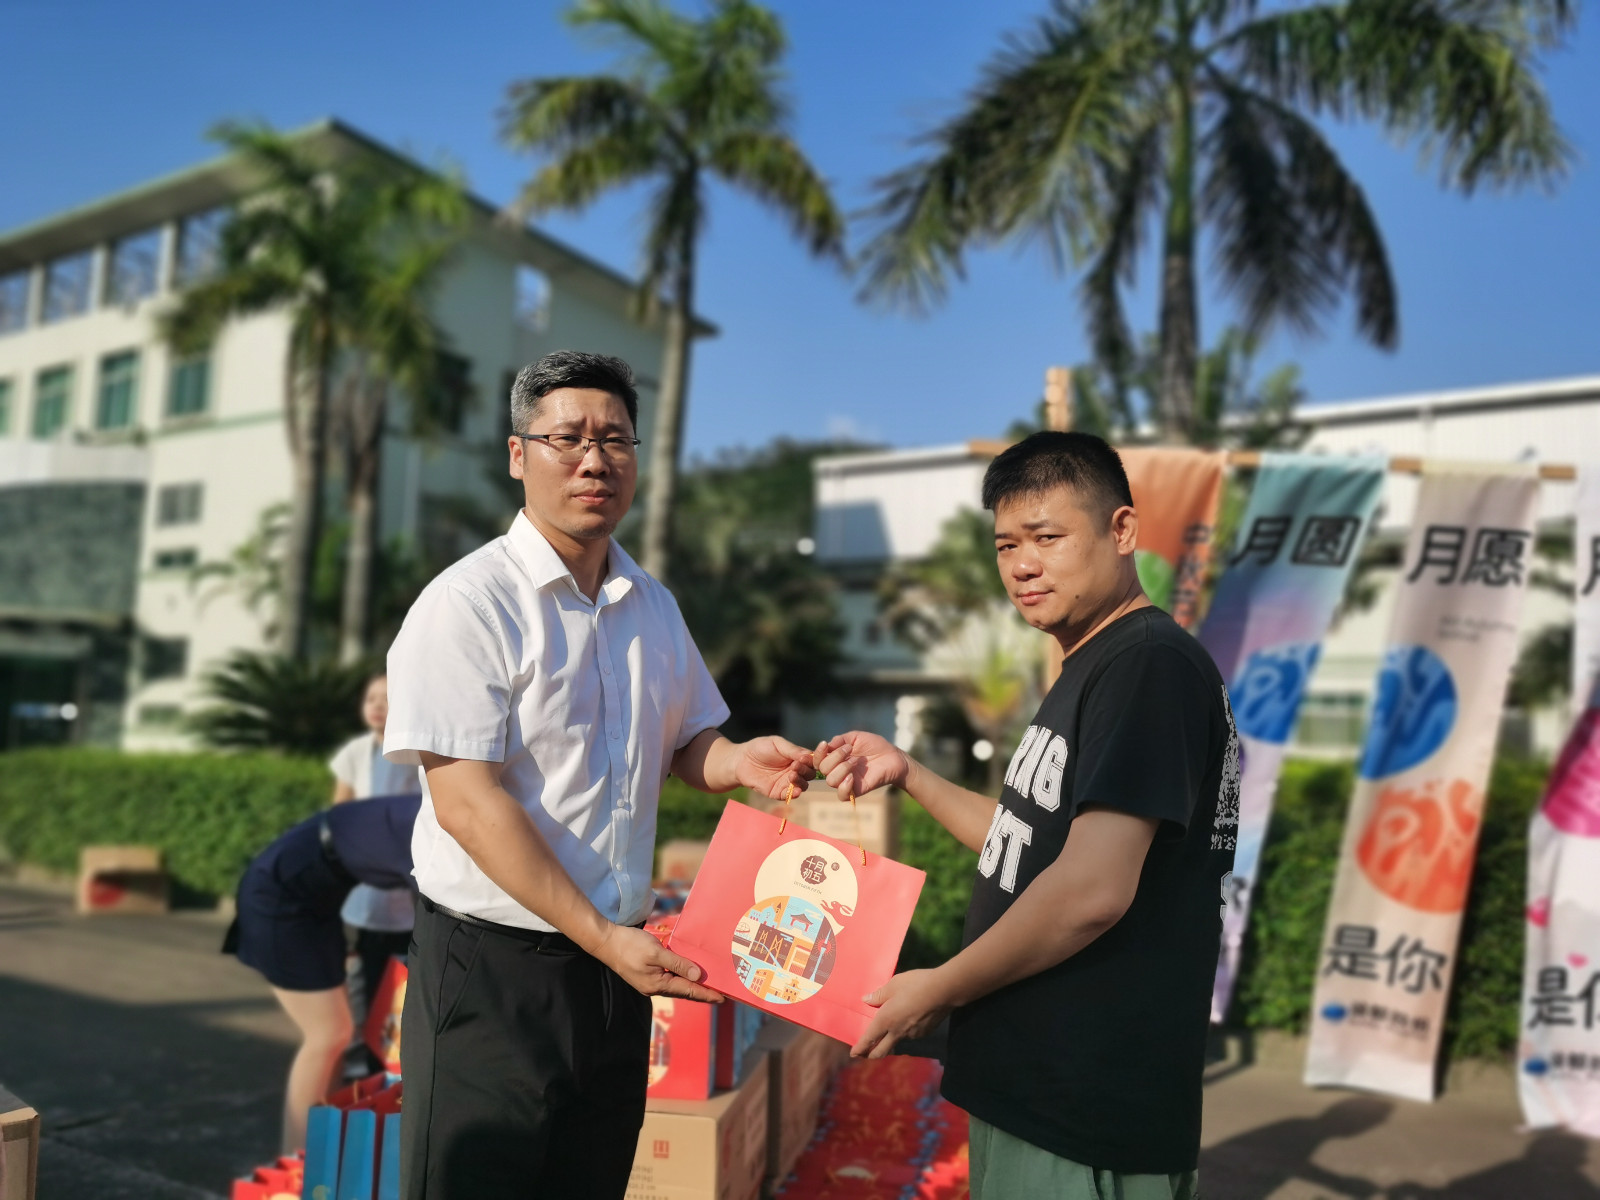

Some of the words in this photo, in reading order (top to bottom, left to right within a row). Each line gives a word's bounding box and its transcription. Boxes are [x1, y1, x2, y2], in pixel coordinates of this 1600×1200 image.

[1407, 525, 1532, 588] 月愿
[802, 867, 822, 882] 初五
[806, 857, 825, 873] 十月
[977, 803, 1033, 894] ST
[1322, 923, 1449, 994] 是你
